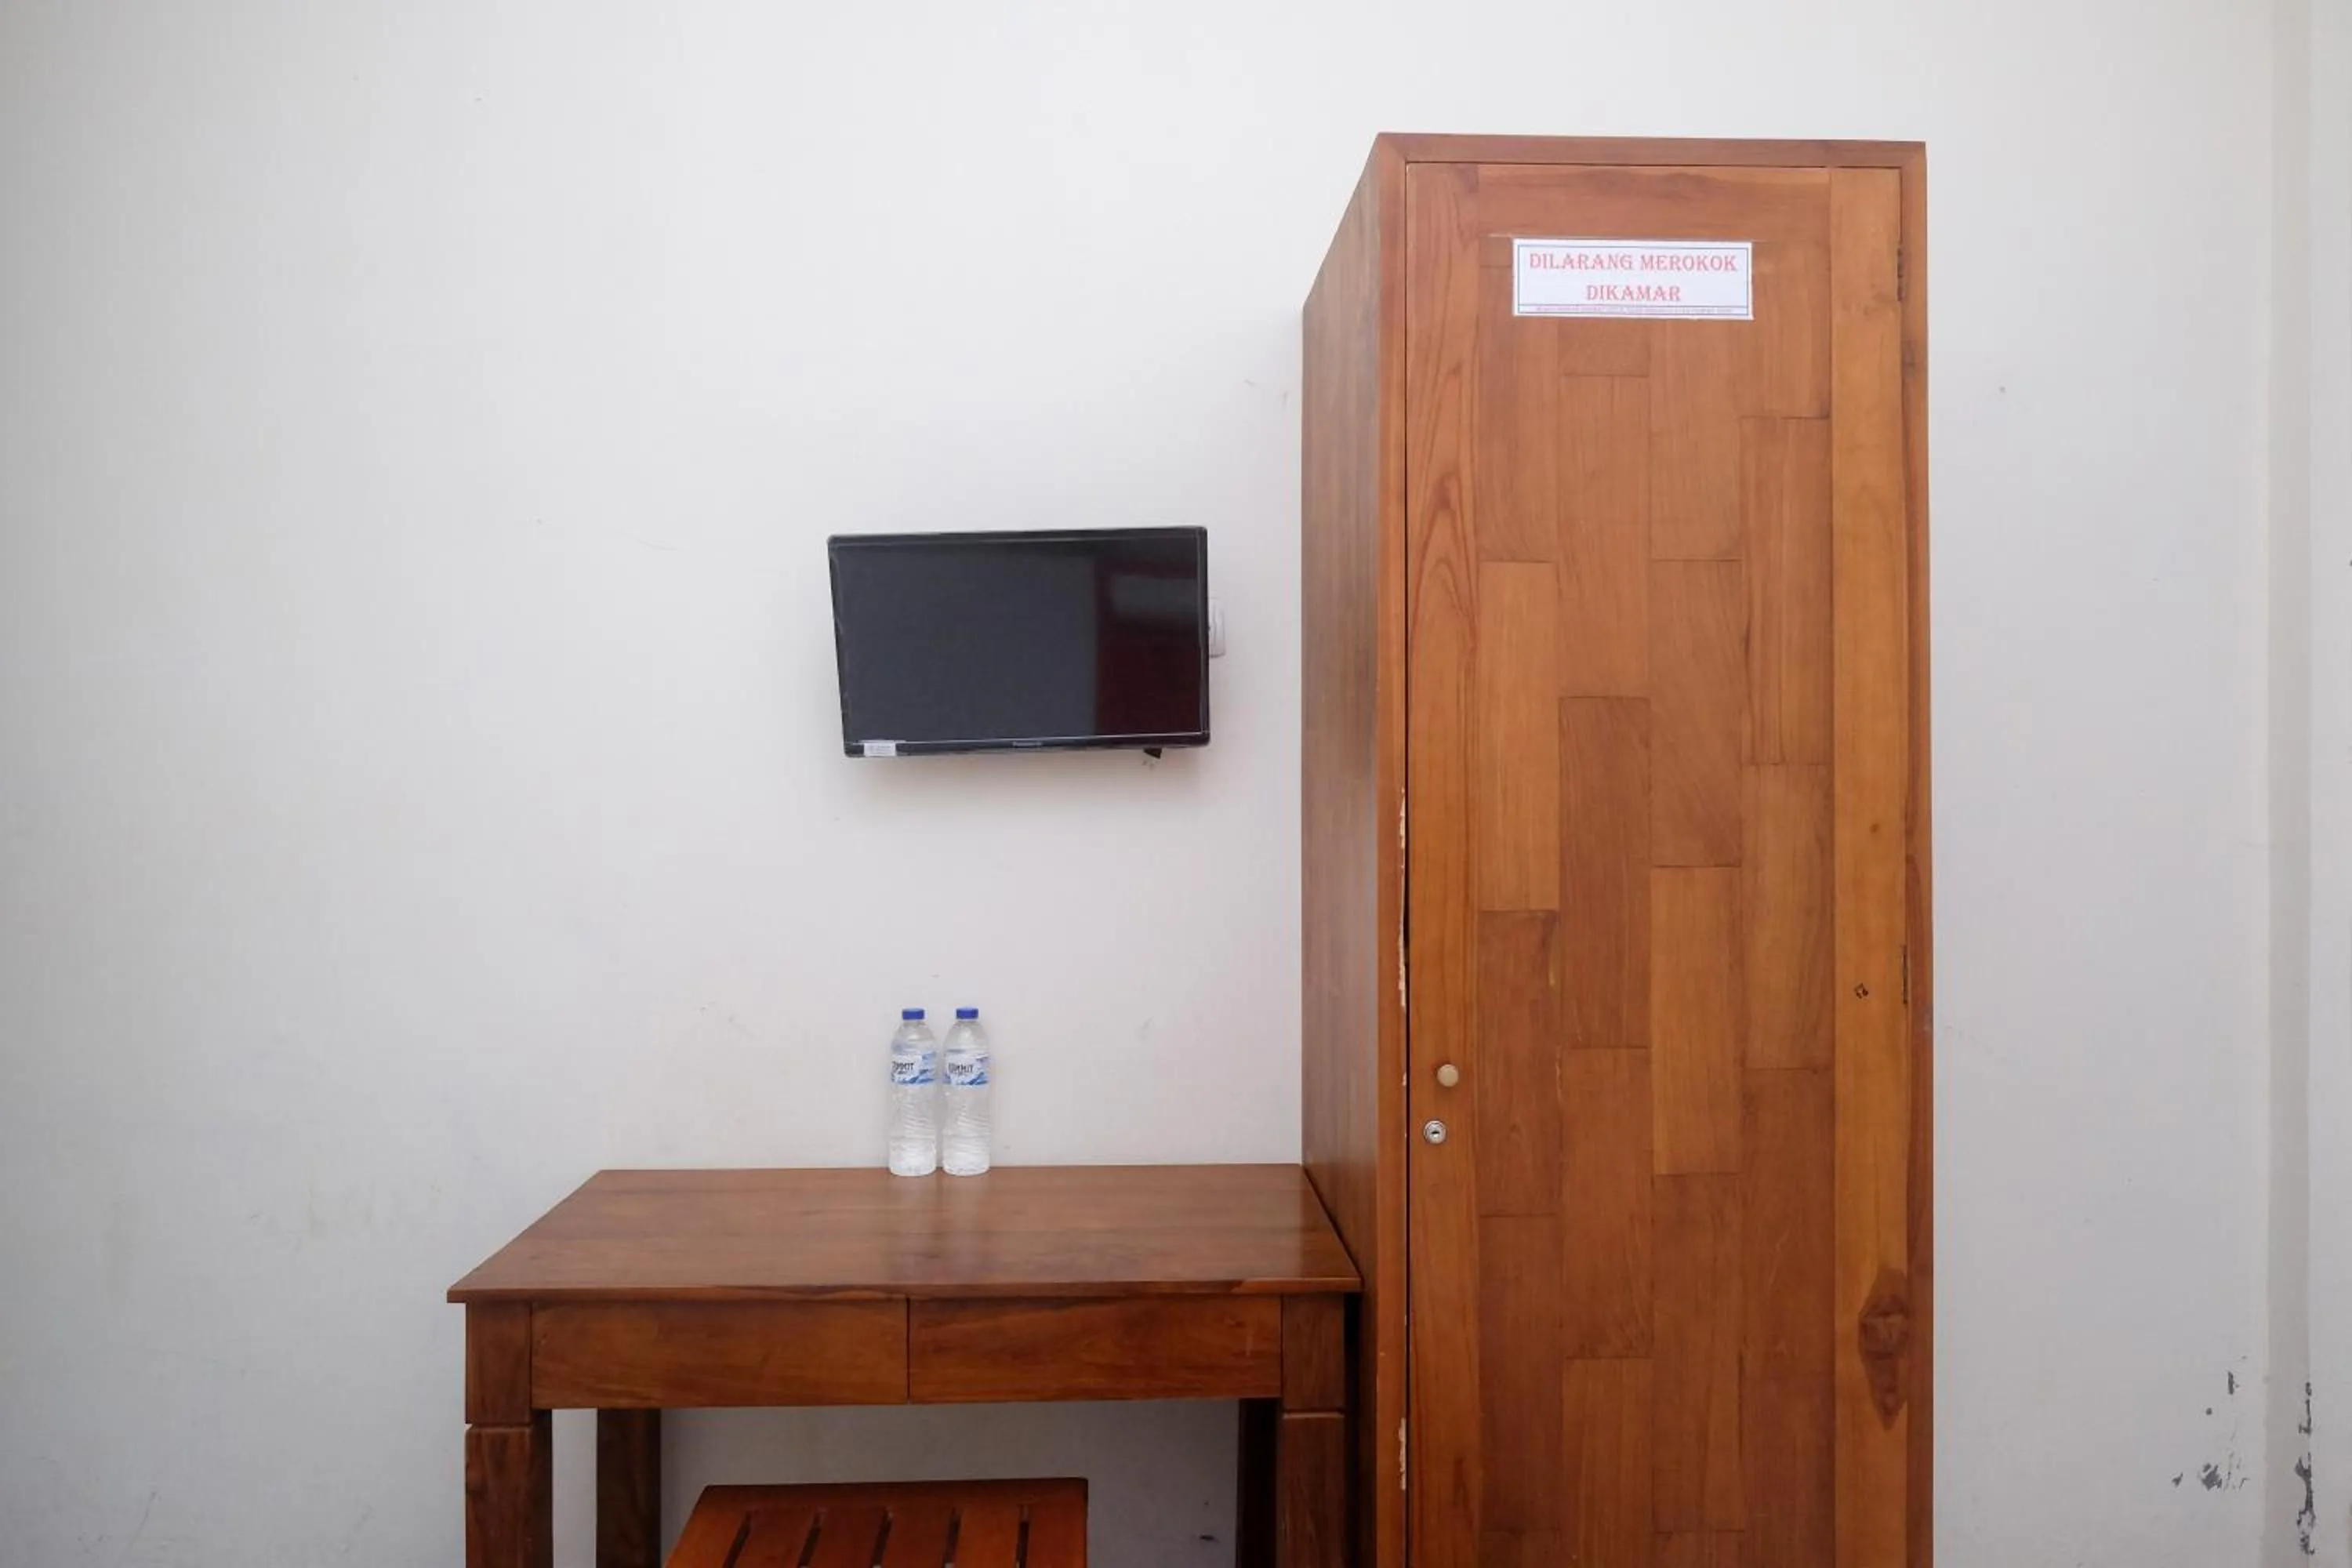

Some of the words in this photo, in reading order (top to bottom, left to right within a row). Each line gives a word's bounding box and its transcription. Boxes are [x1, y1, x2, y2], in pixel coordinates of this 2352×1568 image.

[1529, 252, 1633, 270] DILARANG
[1640, 254, 1737, 272] MEROKOK
[1587, 284, 1681, 302] DIKAMAR
